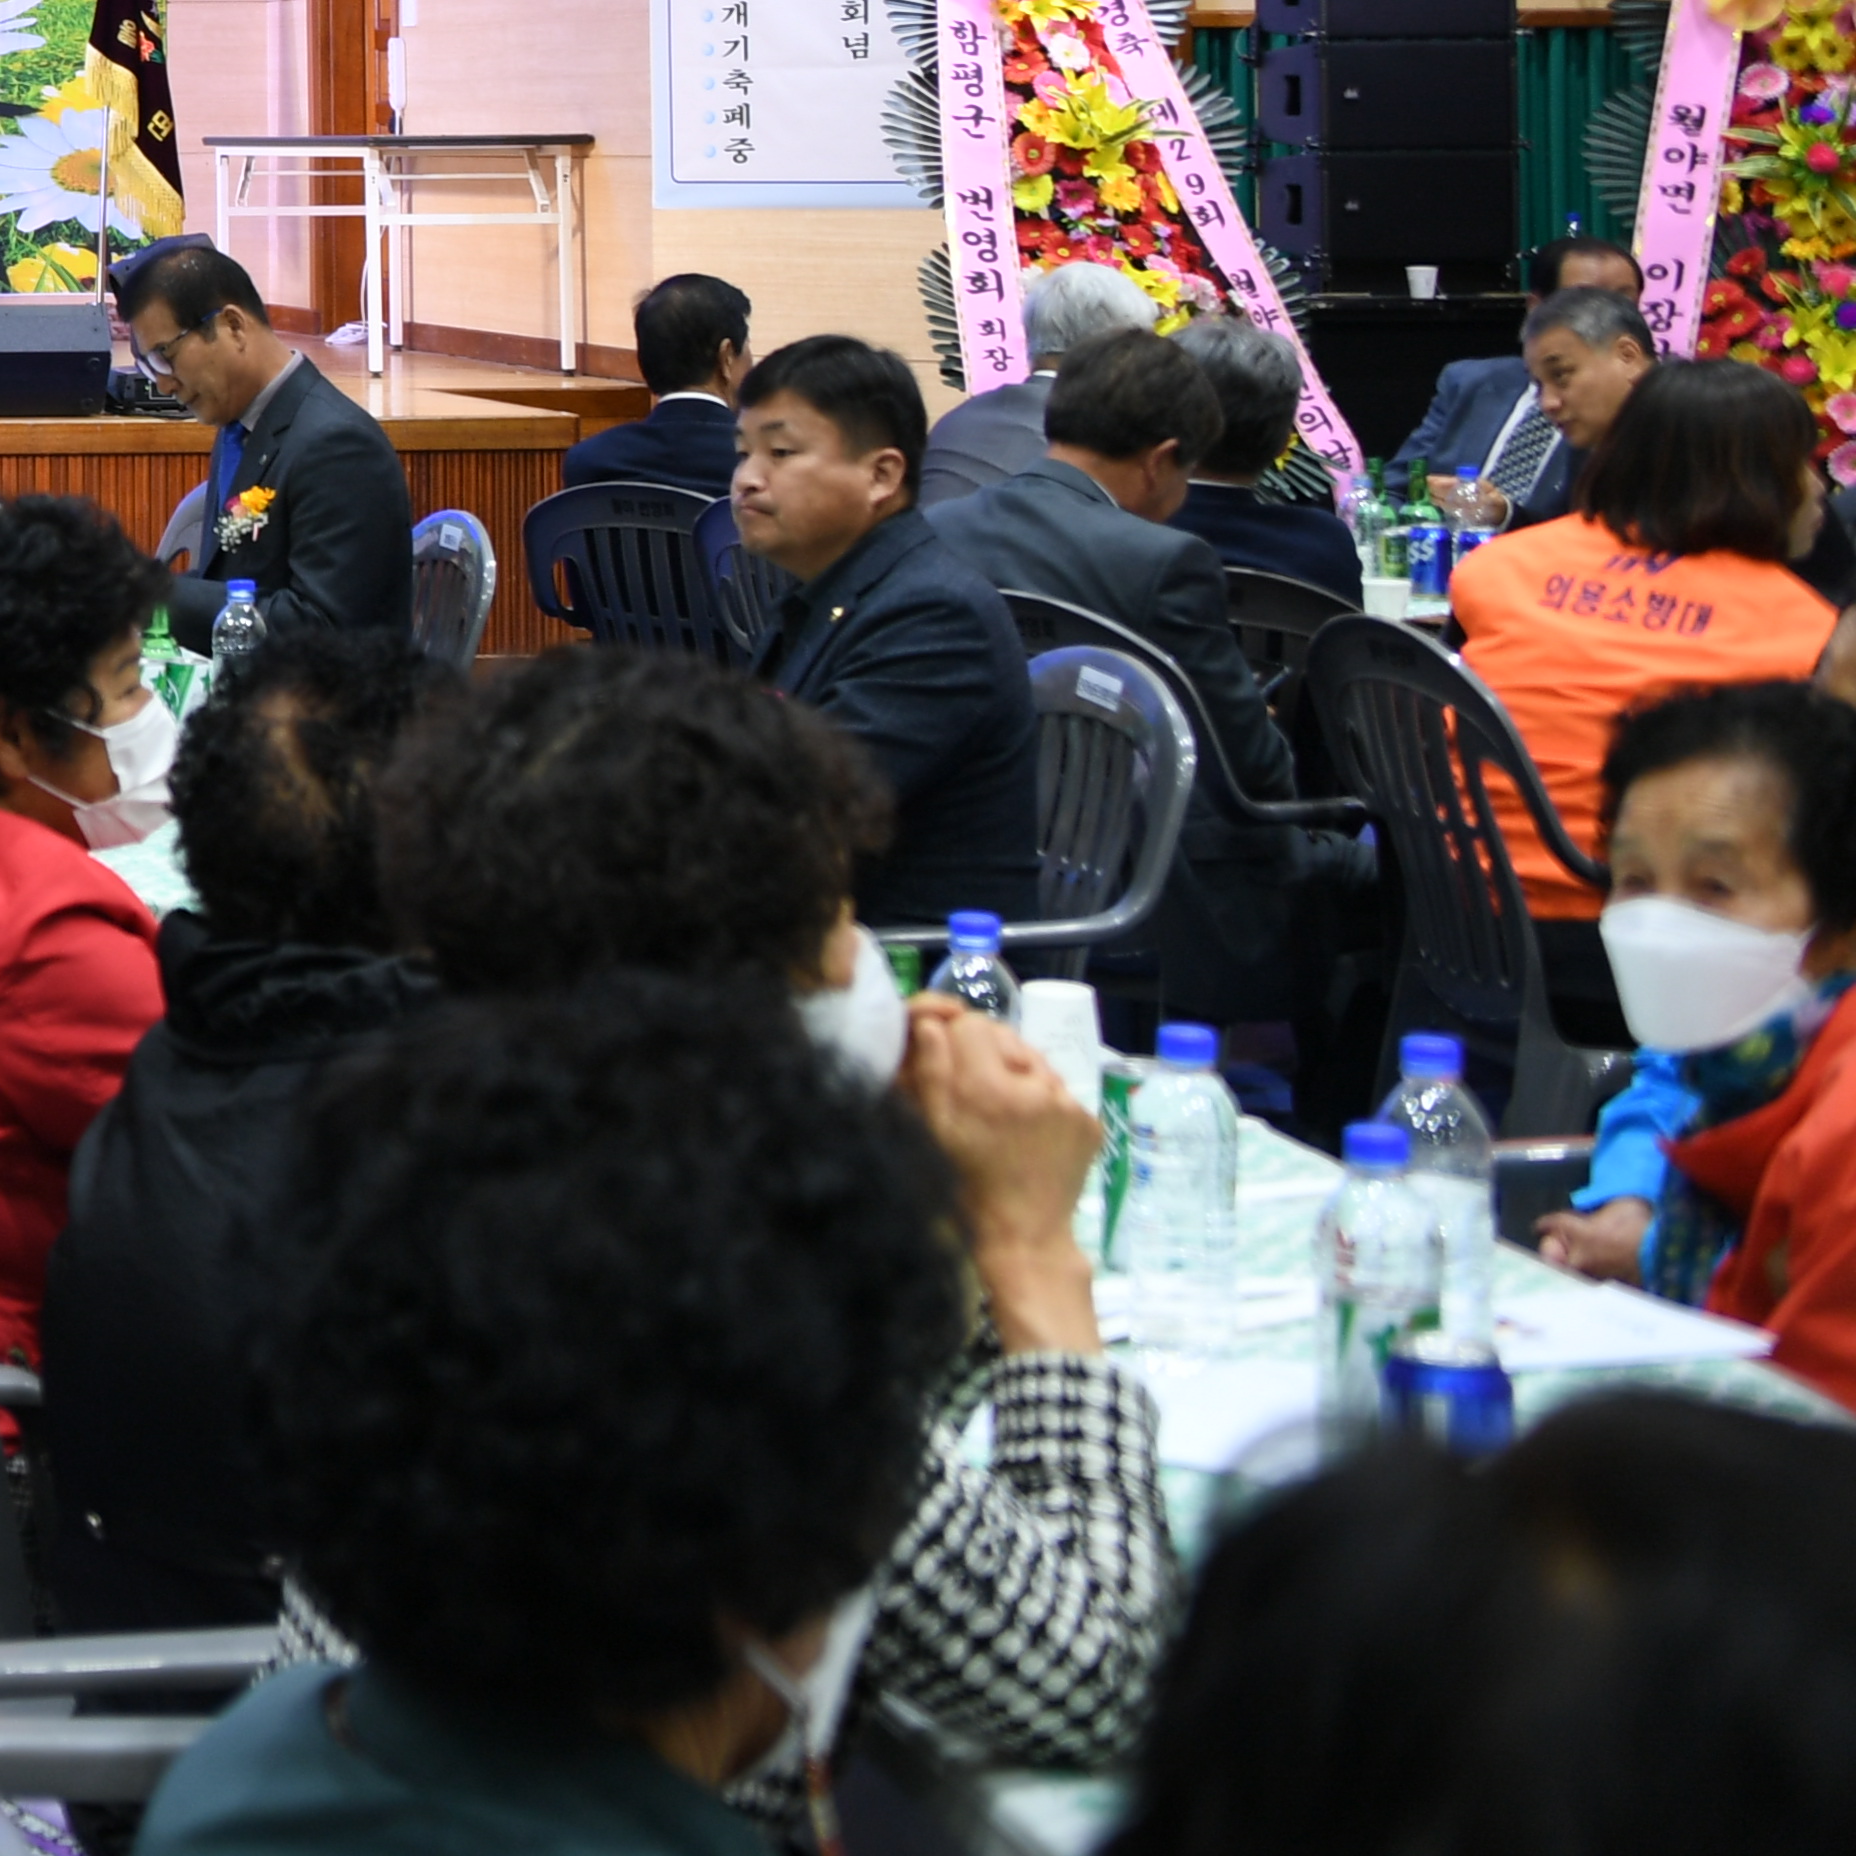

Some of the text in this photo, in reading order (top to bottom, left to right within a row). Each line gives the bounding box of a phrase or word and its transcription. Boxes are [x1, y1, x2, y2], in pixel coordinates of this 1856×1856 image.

[722, 64, 755, 99] 축
[722, 135, 757, 166] 중
[949, 19, 1015, 373] 함평군 번영회 회장
[1538, 573, 1715, 637] 의용소방대
